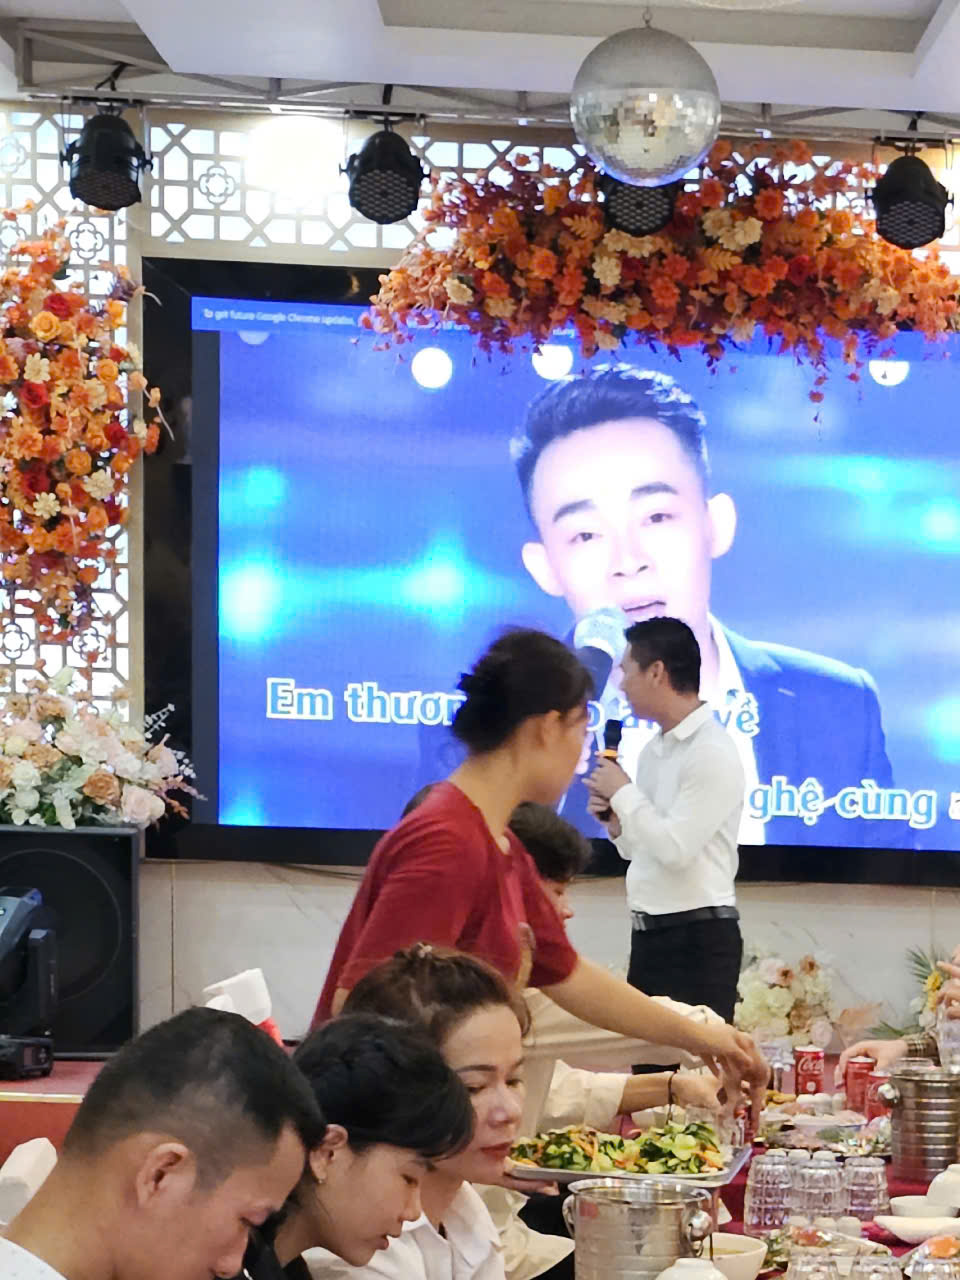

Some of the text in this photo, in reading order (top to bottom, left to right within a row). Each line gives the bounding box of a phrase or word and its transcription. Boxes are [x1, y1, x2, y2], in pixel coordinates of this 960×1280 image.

[266, 677, 334, 720] Em
[344, 681, 467, 726] thươn
[748, 776, 824, 826] ghệ
[835, 779, 937, 829] cùng
